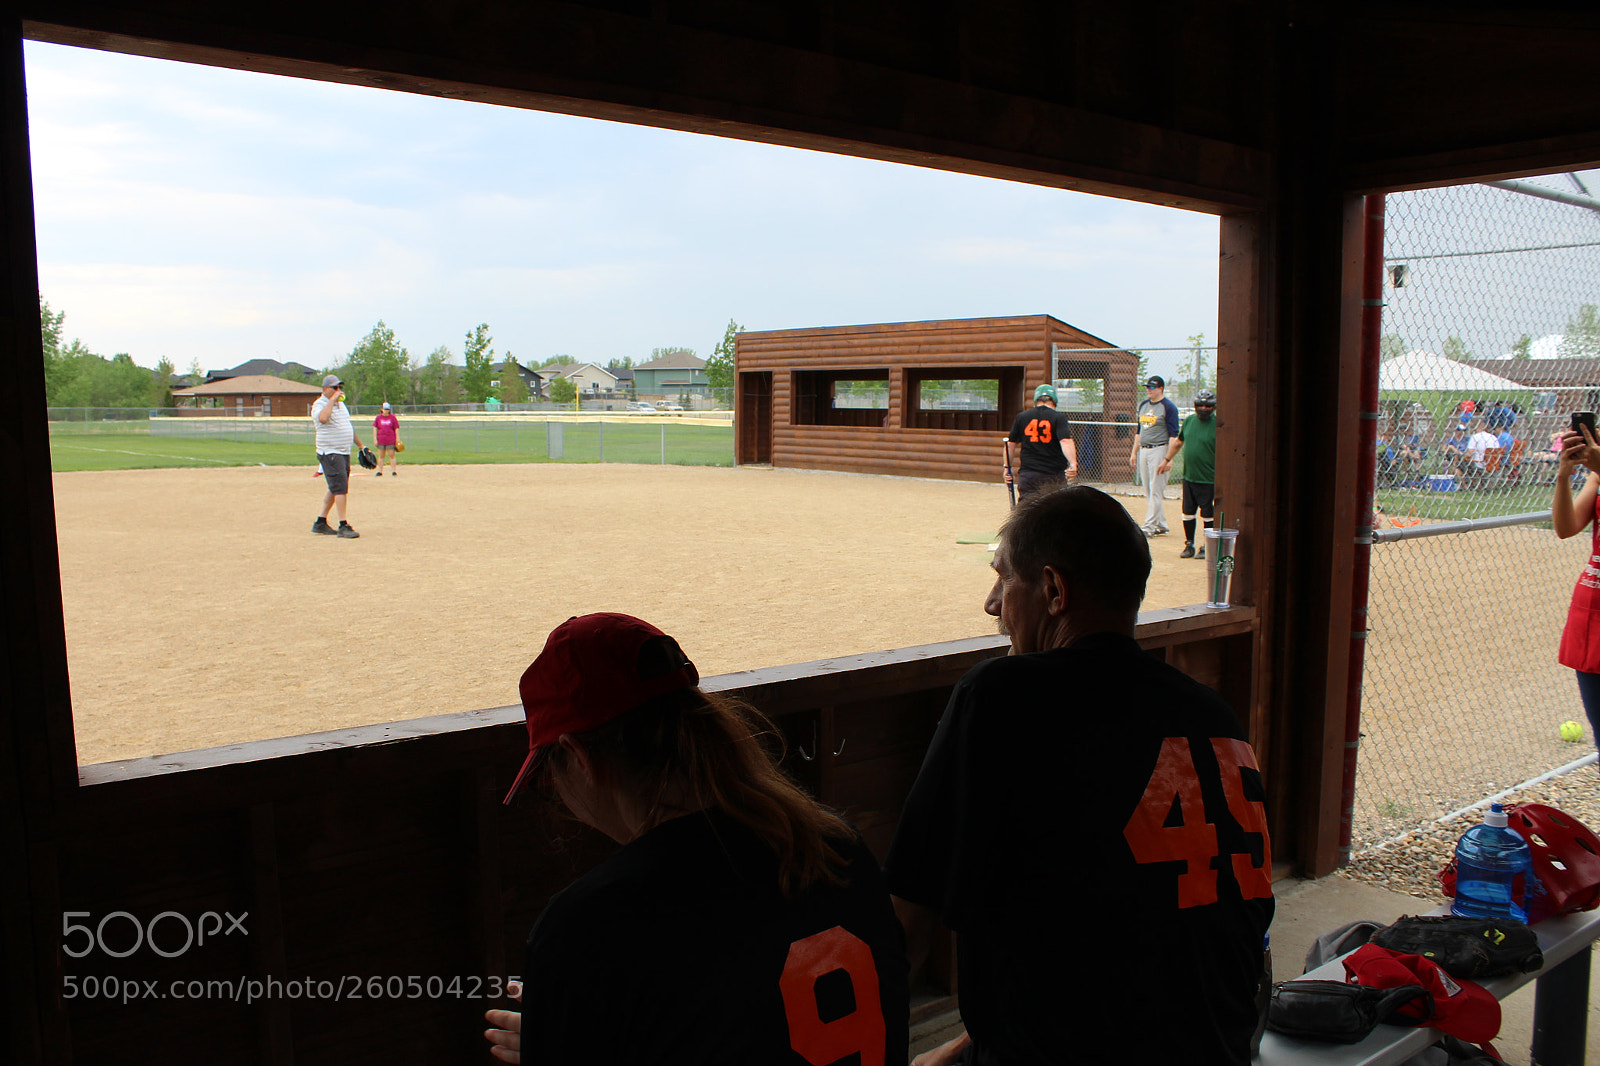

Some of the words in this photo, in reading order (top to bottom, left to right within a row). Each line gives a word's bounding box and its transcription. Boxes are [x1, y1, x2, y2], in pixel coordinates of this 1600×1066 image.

[1024, 418, 1052, 443] 43
[1123, 737, 1273, 910] 45
[779, 926, 886, 1066] 9
